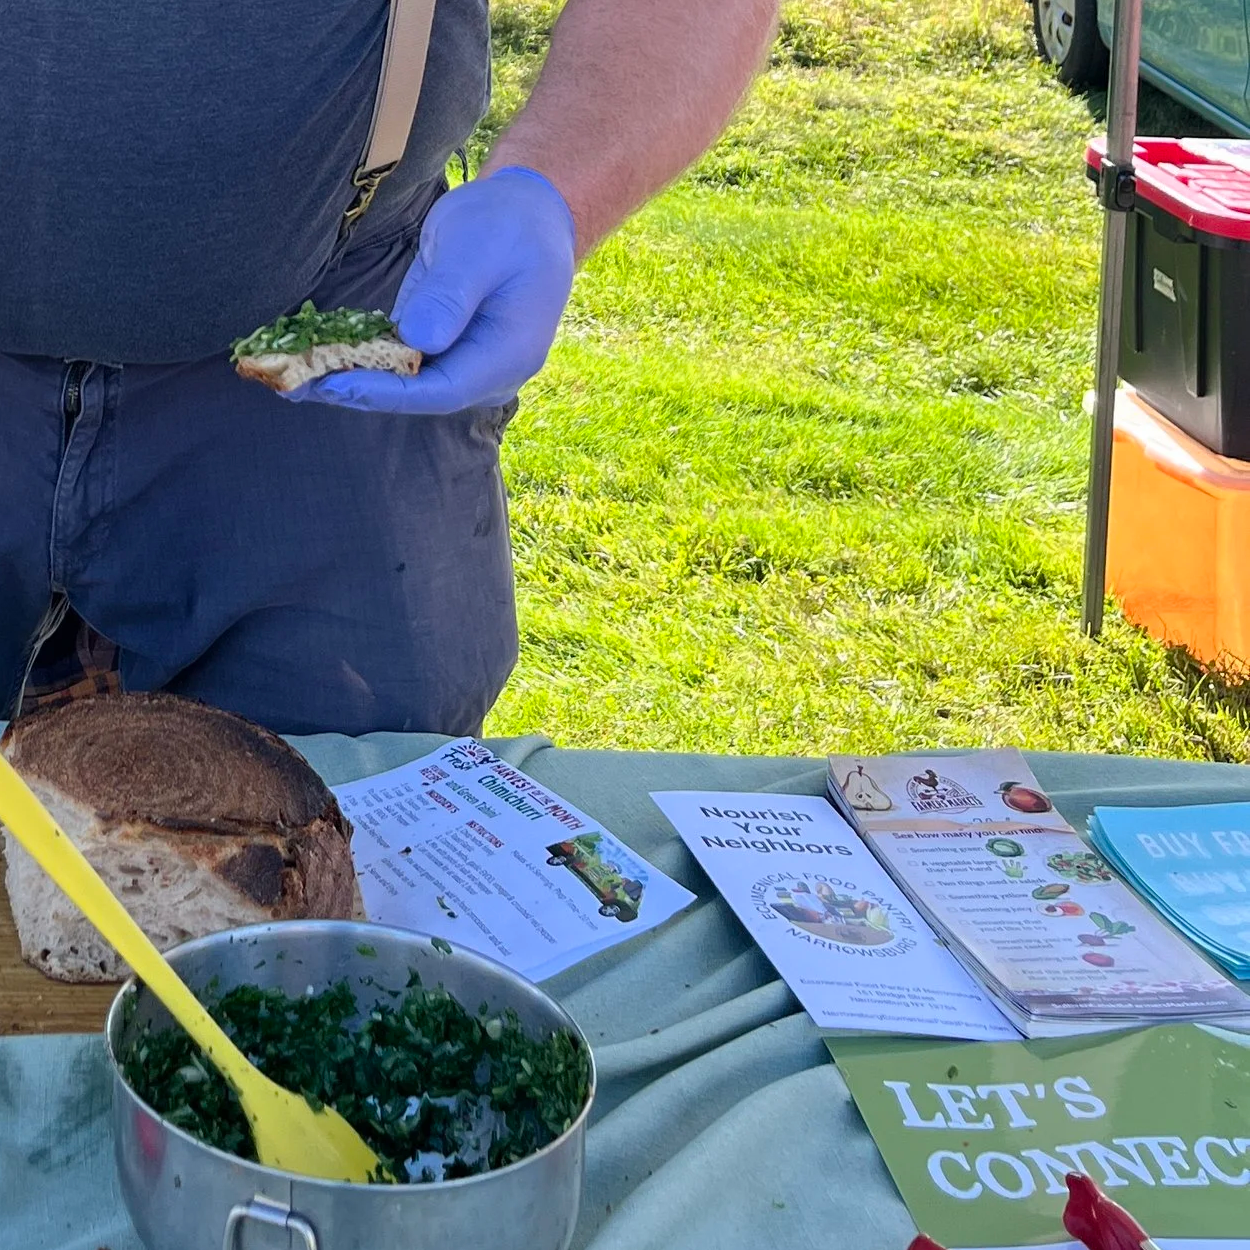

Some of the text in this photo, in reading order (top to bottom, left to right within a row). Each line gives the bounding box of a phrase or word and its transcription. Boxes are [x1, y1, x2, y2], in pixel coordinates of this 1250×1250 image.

[445, 780, 501, 818] and Green Tahini
[478, 775, 548, 820] Chimichurri
[490, 764, 536, 791] HARVEST
[544, 805, 585, 830] MONTH
[947, 795, 983, 808] MARKETS
[700, 806, 814, 823] Nourish
[466, 820, 504, 848] INSTRUCTIONS
[733, 822, 802, 837] Your
[915, 831, 940, 839] how
[975, 830, 997, 839] you
[701, 836, 853, 856] Neighbors
[1136, 831, 1211, 859] BUY
[932, 860, 972, 868] vegetable
[750, 871, 918, 933] ECUMENICAL FOOD PANTRY
[786, 928, 918, 958] NARROWSBURG
[883, 1076, 1107, 1130] LET'S
